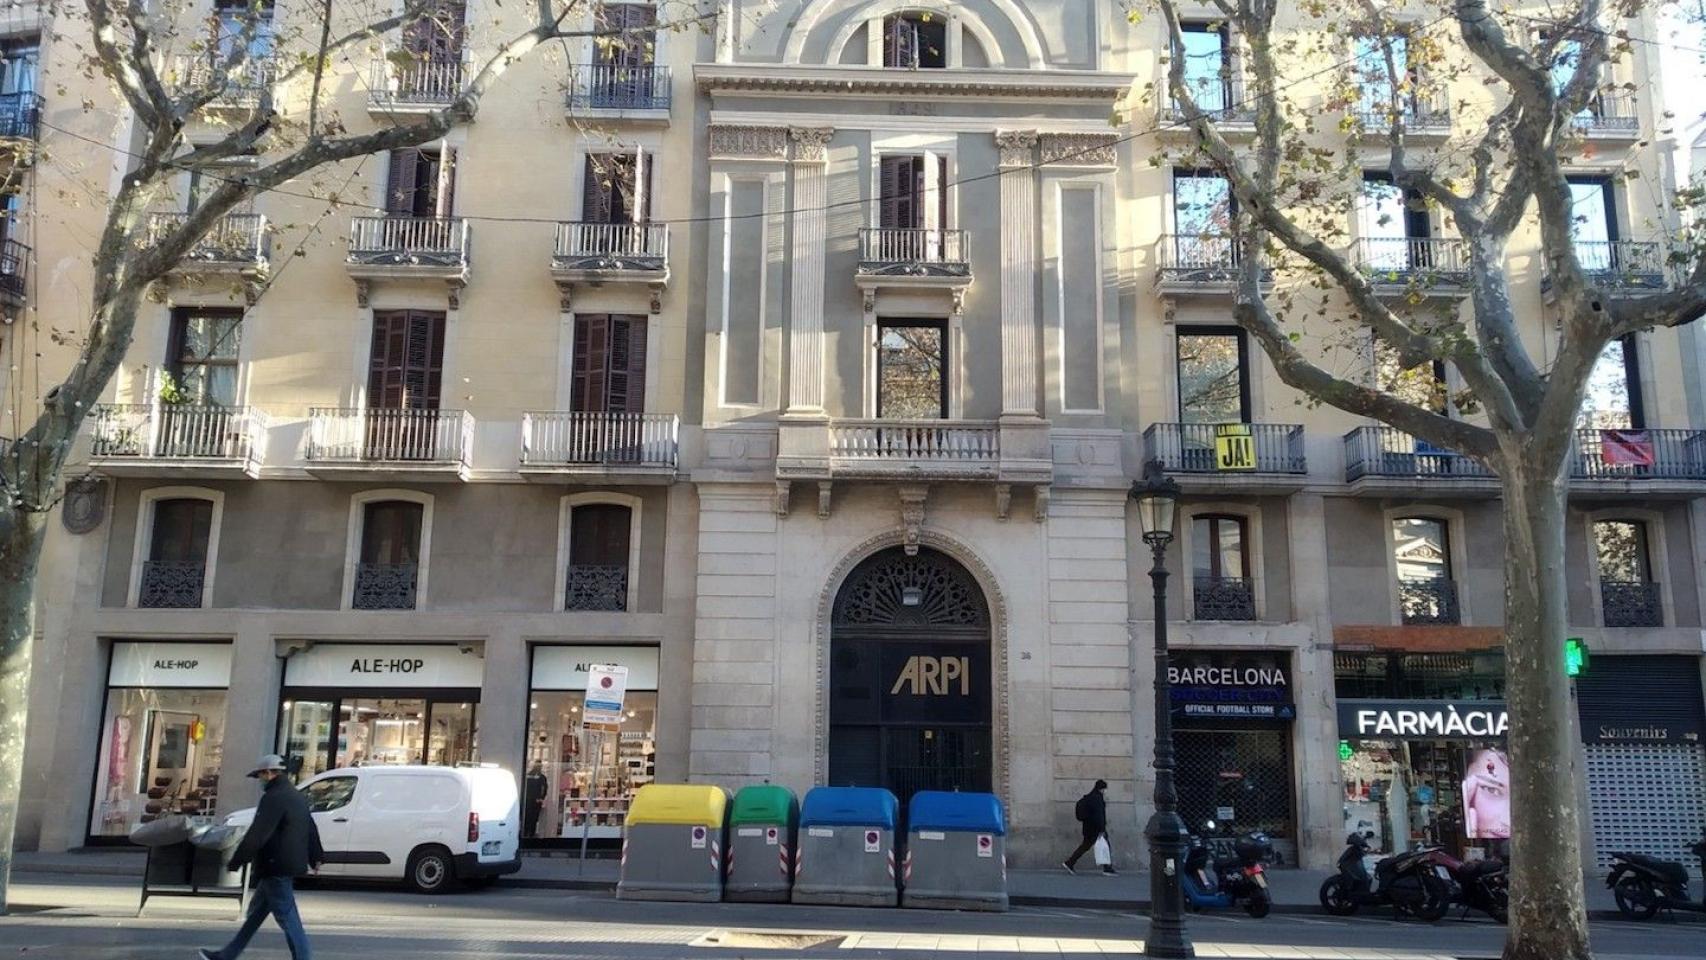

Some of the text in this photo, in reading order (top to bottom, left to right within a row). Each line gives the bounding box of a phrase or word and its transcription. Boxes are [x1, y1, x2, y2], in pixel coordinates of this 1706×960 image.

[1222, 438, 1251, 467] JA!
[153, 660, 199, 669] ALE-HOP
[350, 658, 424, 673] ALE-HOP
[890, 655, 969, 696] ARPI
[1167, 667, 1287, 685] BARCELONA
[1184, 704, 1275, 715] OFFICIAL FOOTBALL STORE
